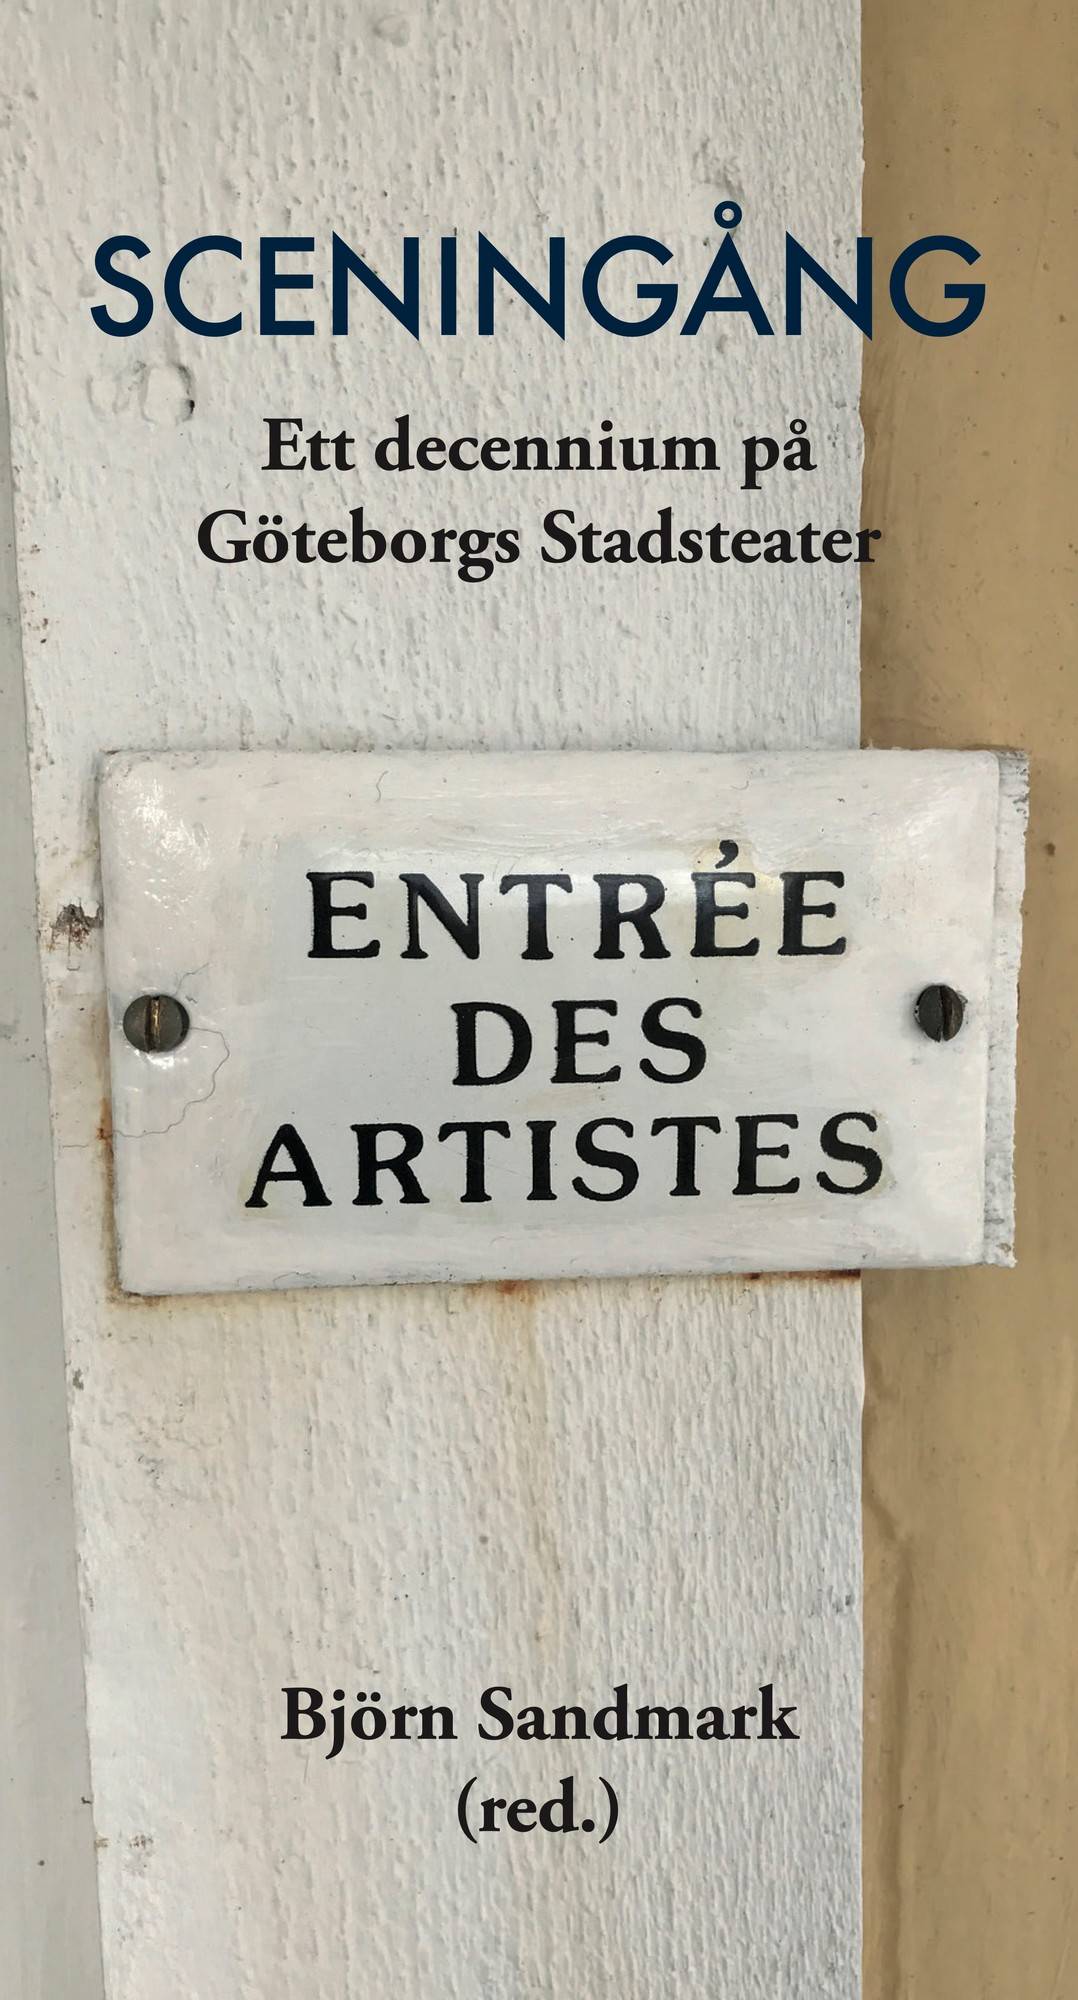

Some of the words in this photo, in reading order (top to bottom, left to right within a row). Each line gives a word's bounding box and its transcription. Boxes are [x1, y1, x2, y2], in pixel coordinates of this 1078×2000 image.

[306, 839, 848, 961] ENTRÉE
[450, 997, 708, 1087] DES
[244, 1110, 884, 1209] ARTISTES
